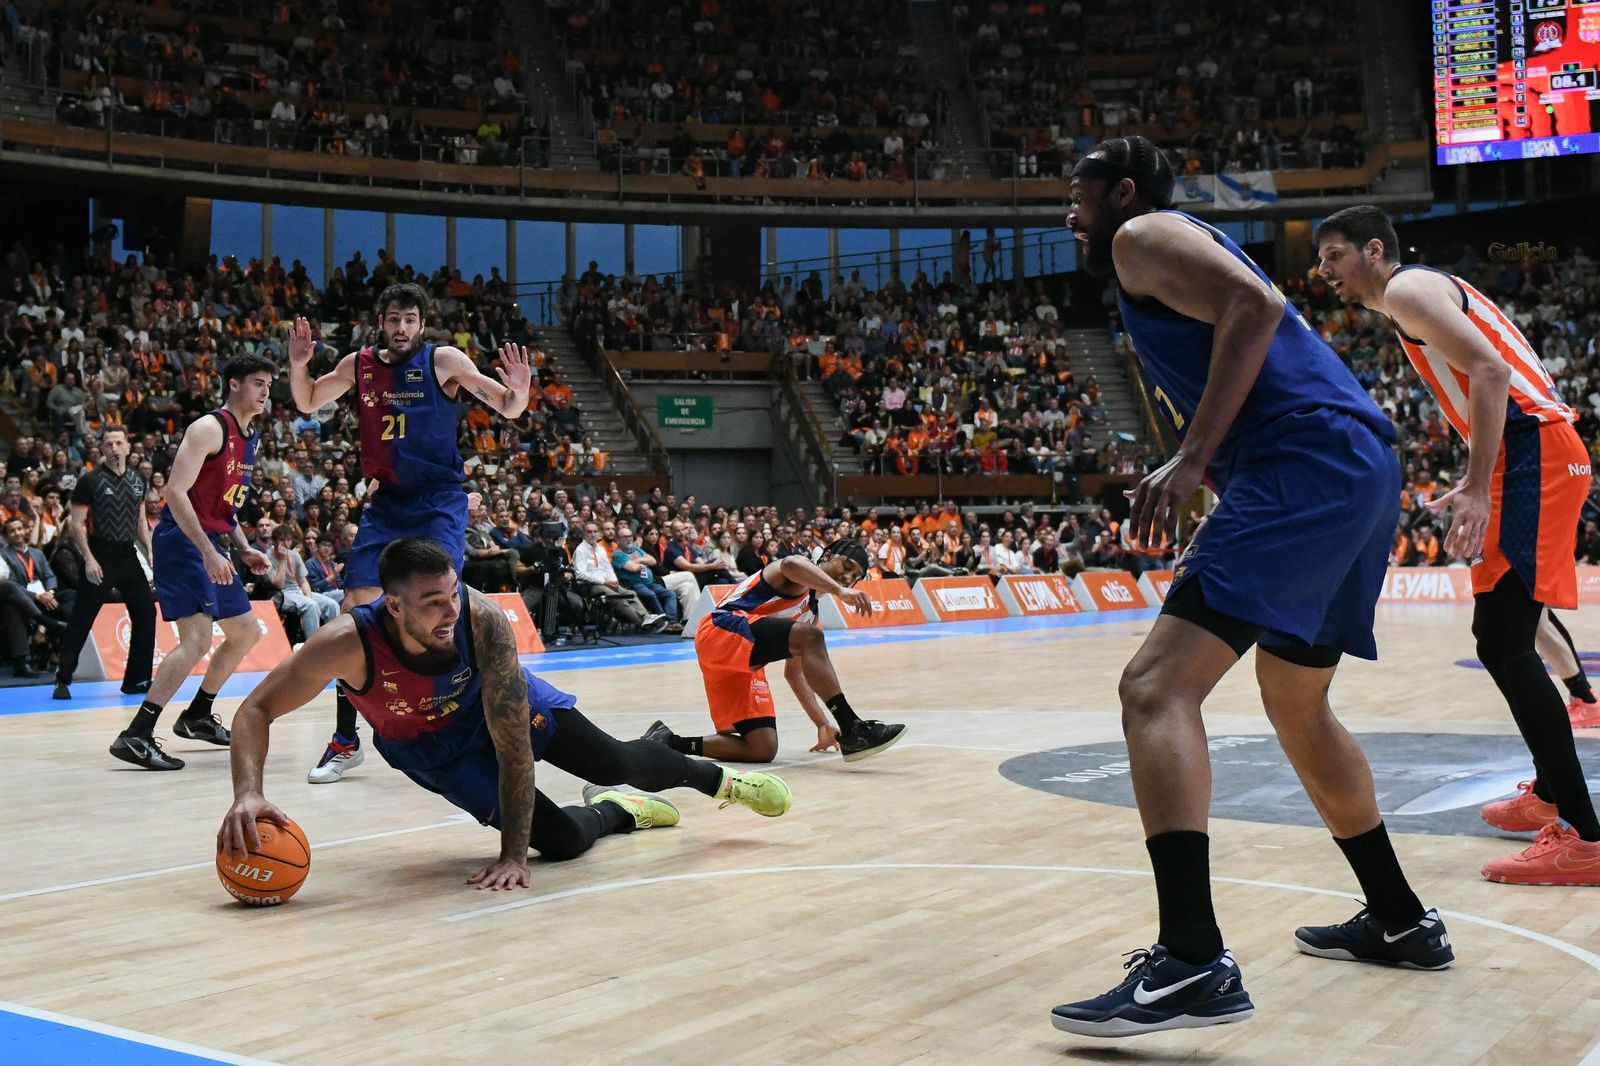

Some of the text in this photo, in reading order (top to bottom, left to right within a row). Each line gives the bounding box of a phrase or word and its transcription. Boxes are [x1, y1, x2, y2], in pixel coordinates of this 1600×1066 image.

[1488, 242, 1558, 262] Galicia
[674, 398, 696, 406] SALIDA
[680, 407, 690, 416] DE
[381, 413, 406, 440] 21
[664, 417, 706, 425] EMERGENCIA
[223, 483, 249, 509] 45
[1013, 580, 1063, 611] LEYMA
[1379, 572, 1457, 599] LEYMA
[234, 863, 274, 882] EVO
